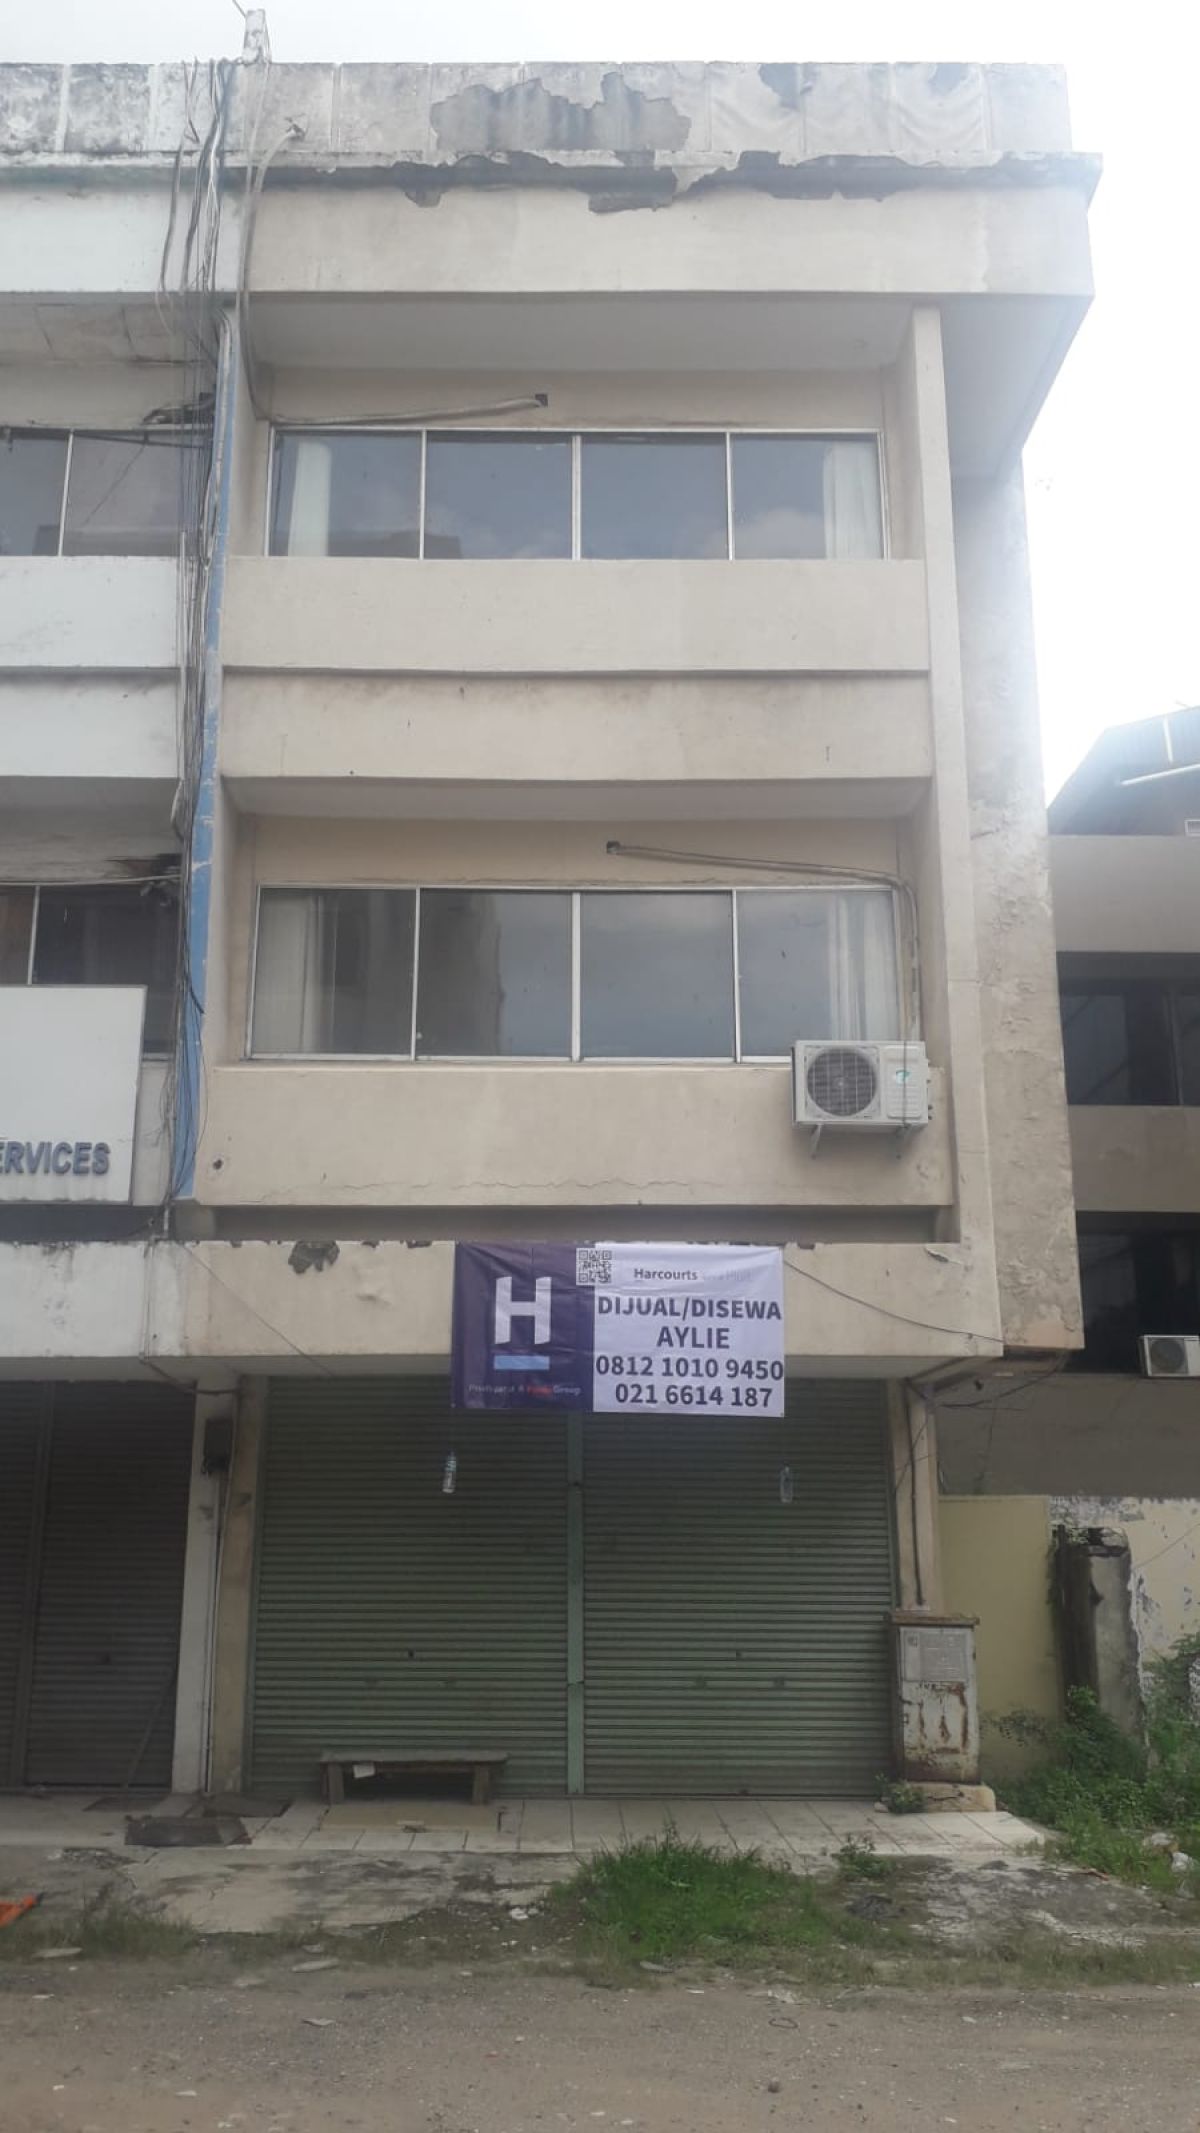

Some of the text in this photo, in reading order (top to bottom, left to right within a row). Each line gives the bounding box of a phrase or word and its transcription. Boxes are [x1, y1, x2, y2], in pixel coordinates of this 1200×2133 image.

[0, 1141, 110, 1175] RVICES
[634, 1268, 698, 1281] Harcourts
[494, 1276, 552, 1345] H
[598, 1296, 782, 1321] DIJUAL/DISEWA
[656, 1326, 730, 1349] AYLIE
[596, 1355, 784, 1381] 0812 1010 9450
[615, 1383, 772, 1408] 021 6614 187
